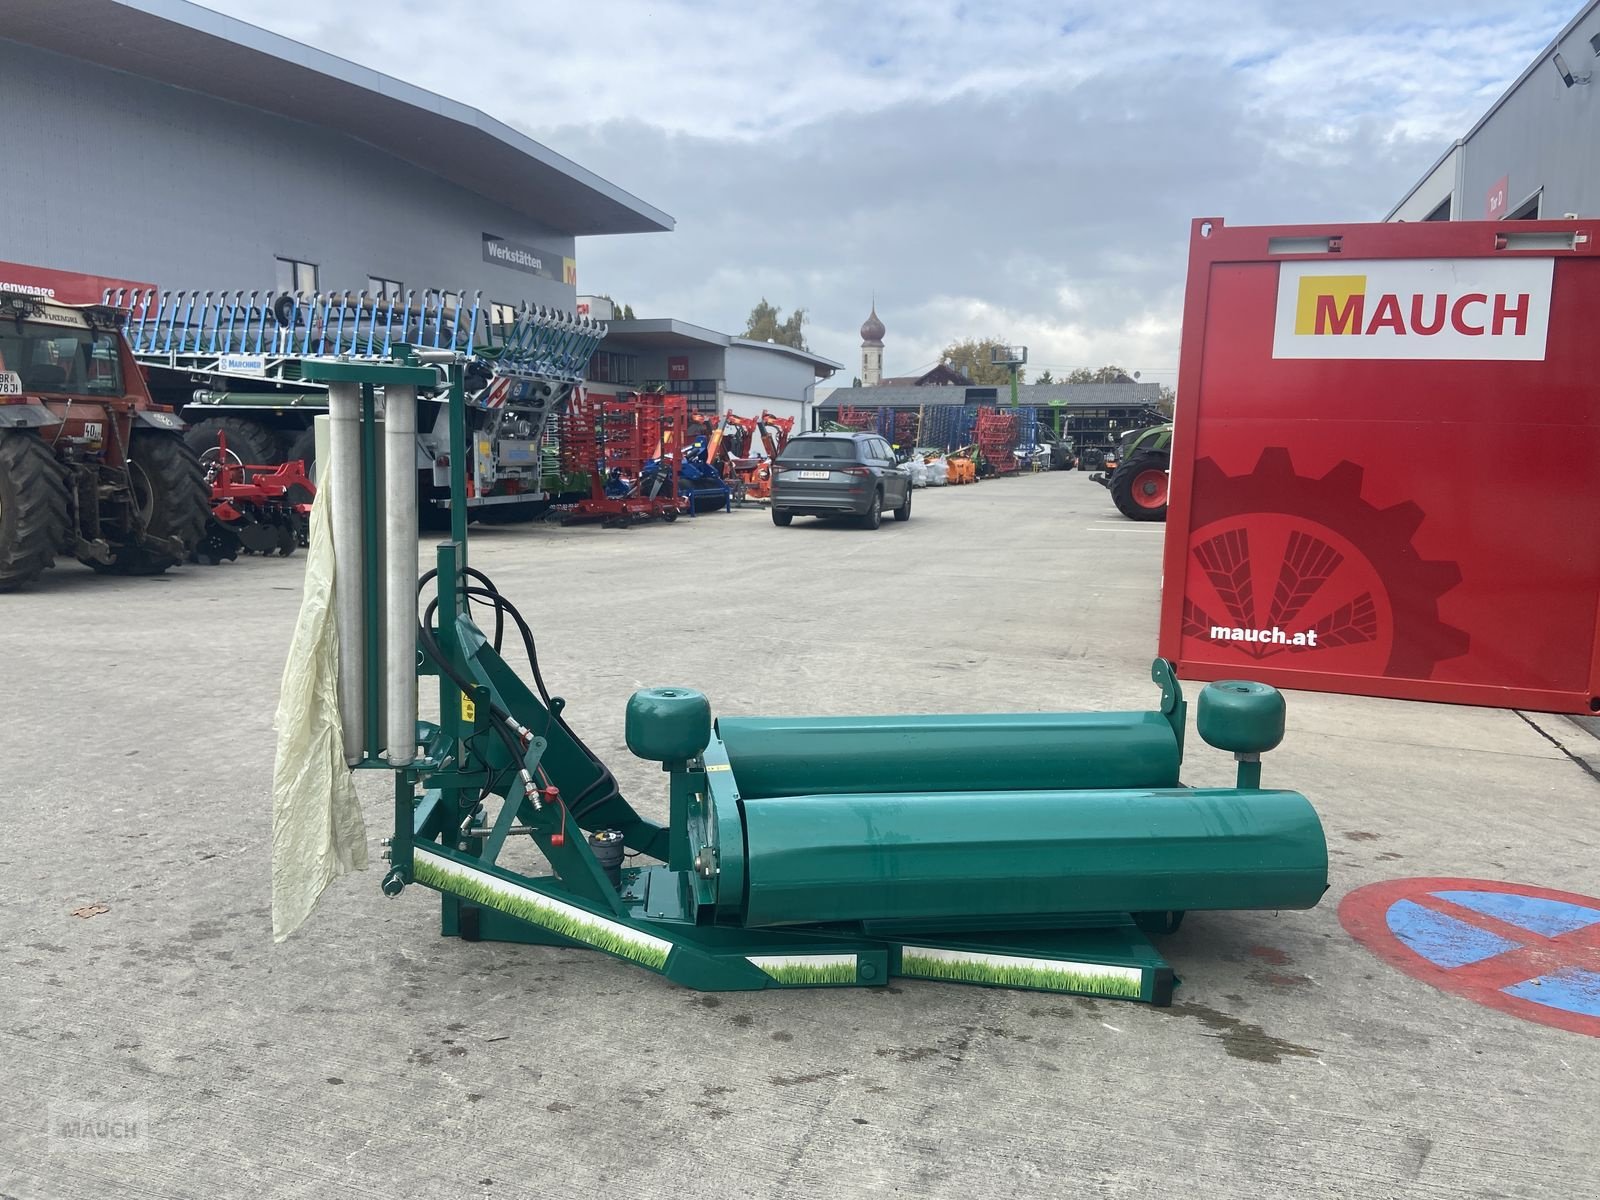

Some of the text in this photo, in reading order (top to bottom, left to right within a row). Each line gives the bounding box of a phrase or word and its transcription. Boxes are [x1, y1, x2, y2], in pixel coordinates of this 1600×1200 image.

[488, 241, 542, 269] Werkstätten
[1314, 293, 1530, 336] MAUCH
[85, 424, 96, 437] 40
[1210, 626, 1318, 647] mauch.at
